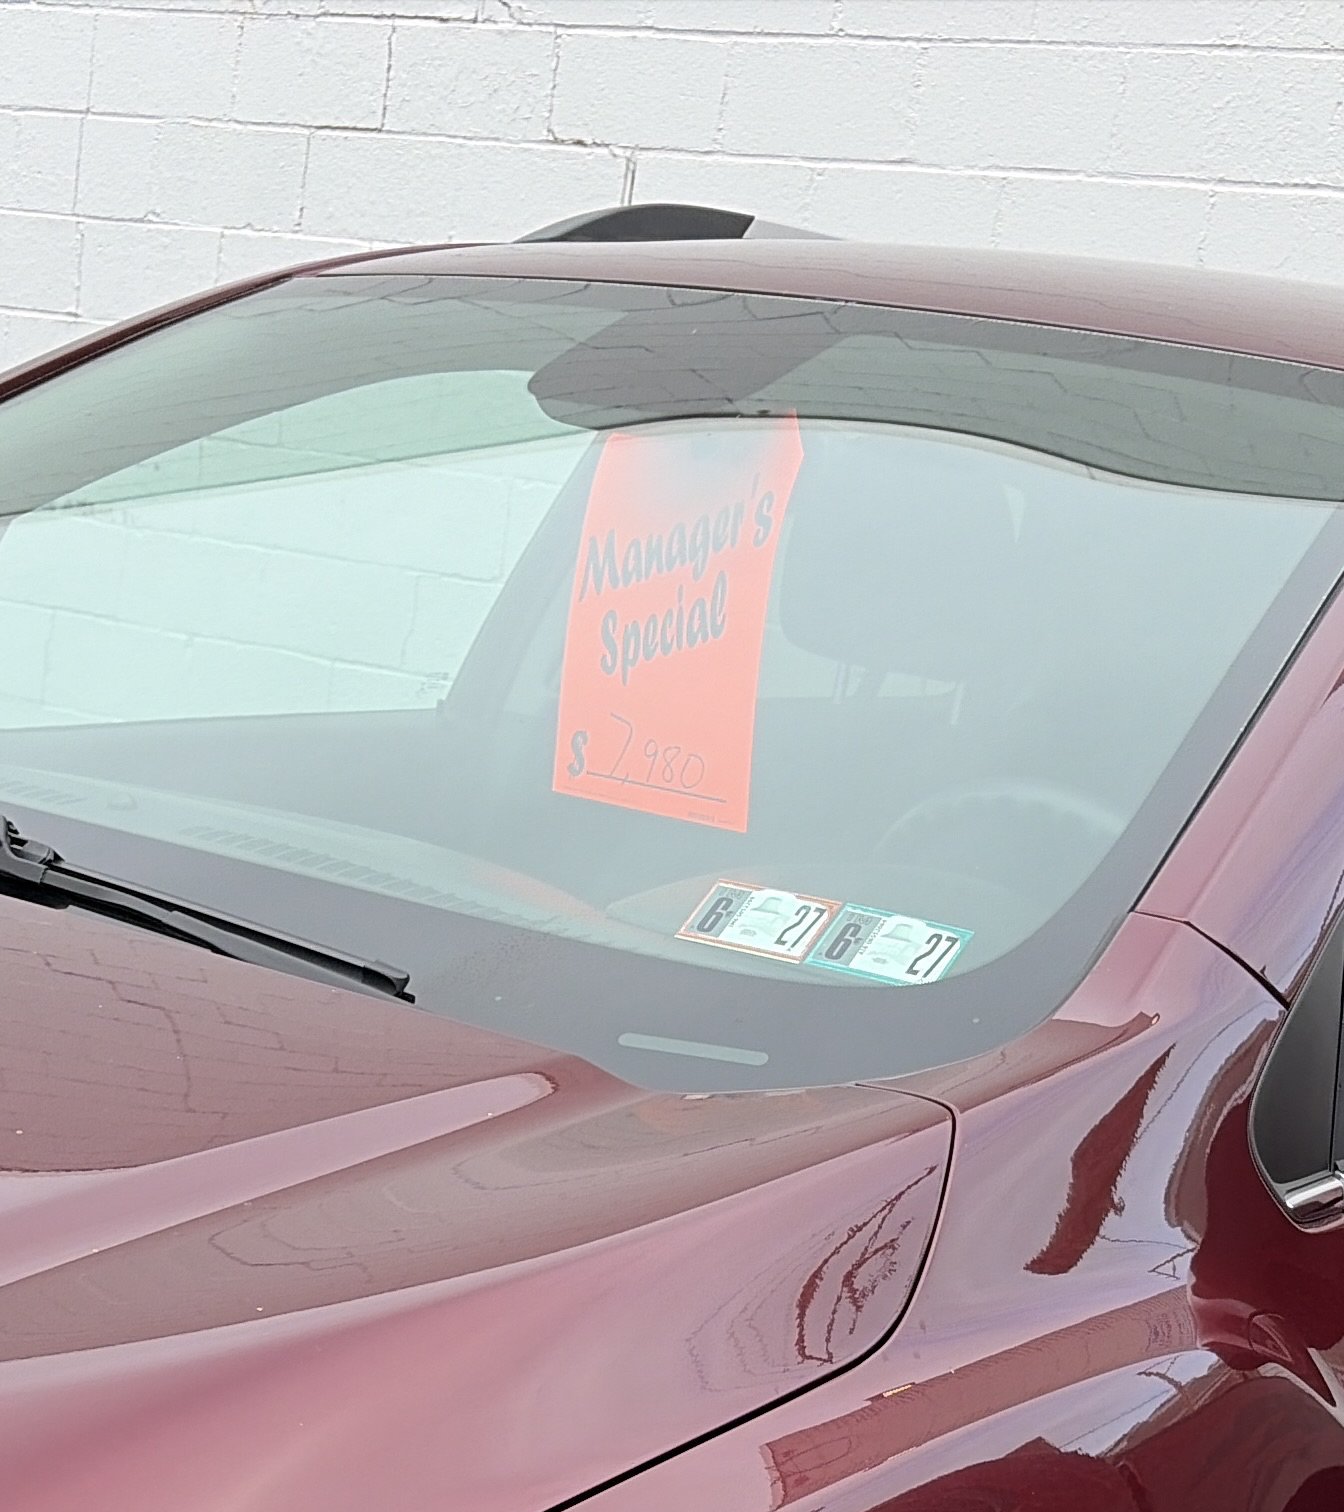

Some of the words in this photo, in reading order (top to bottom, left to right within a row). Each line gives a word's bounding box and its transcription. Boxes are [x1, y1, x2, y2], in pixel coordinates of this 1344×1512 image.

[578, 472, 775, 603] Manager's
[600, 570, 728, 687] Special
[696, 897, 734, 932] 6
[774, 904, 827, 950] 27
[824, 922, 862, 960] 6
[905, 933, 960, 979] 27
